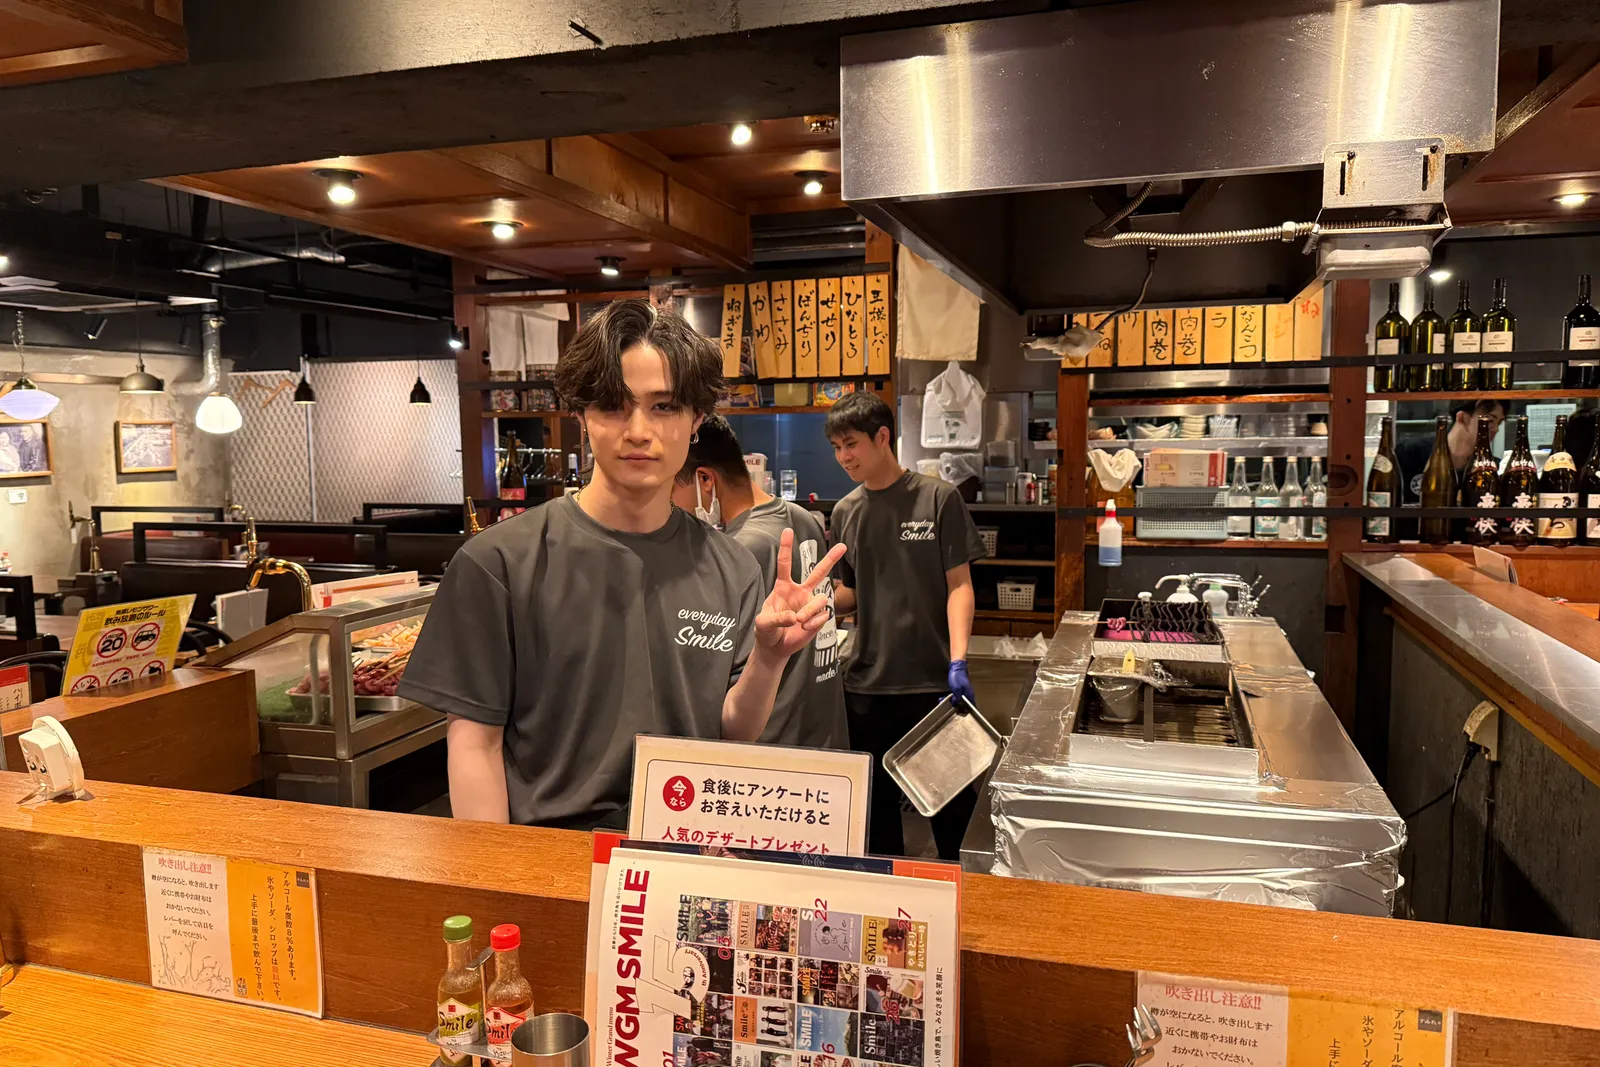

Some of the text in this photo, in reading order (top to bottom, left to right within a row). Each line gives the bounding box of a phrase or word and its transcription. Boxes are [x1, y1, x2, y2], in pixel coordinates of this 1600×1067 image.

[723, 298, 741, 349] ねぎま
[752, 294, 770, 343] かわ
[774, 293, 789, 355] ささみ
[820, 293, 837, 351] せせり
[844, 292, 862, 358] ひなとろ
[1239, 305, 1257, 358] なんこつ
[900, 530, 936, 541] Smile
[901, 519, 935, 534] everyday
[677, 608, 736, 629] everyday
[100, 637, 124, 654] 20
[674, 626, 734, 652] Smile
[672, 779, 687, 797] 今
[701, 778, 829, 804] 食後にアンケートに
[669, 797, 687, 807] なら
[700, 799, 830, 826] お答えいただけると
[661, 825, 830, 854] 人気のデザートプレゼント
[676, 894, 692, 942] SMILE
[814, 898, 828, 923] 22
[897, 907, 913, 932] 27
[616, 869, 650, 980] SMILE
[740, 912, 751, 946] SMILE
[718, 936, 732, 961] 03
[867, 919, 878, 963] SMILE
[1165, 984, 1263, 1010] 吹き出し注意!!
[438, 1010, 474, 1033] Smile
[485, 1016, 514, 1040] Smil
[740, 1012, 749, 1038] Smile
[801, 1009, 813, 1048] SMILE
[865, 1018, 877, 1055] Smile
[1165, 1026, 1259, 1048] 近くに携帯やお財布は
[1391, 1008, 1406, 1067] アルコール
[1171, 1044, 1255, 1066] おかないでください。
